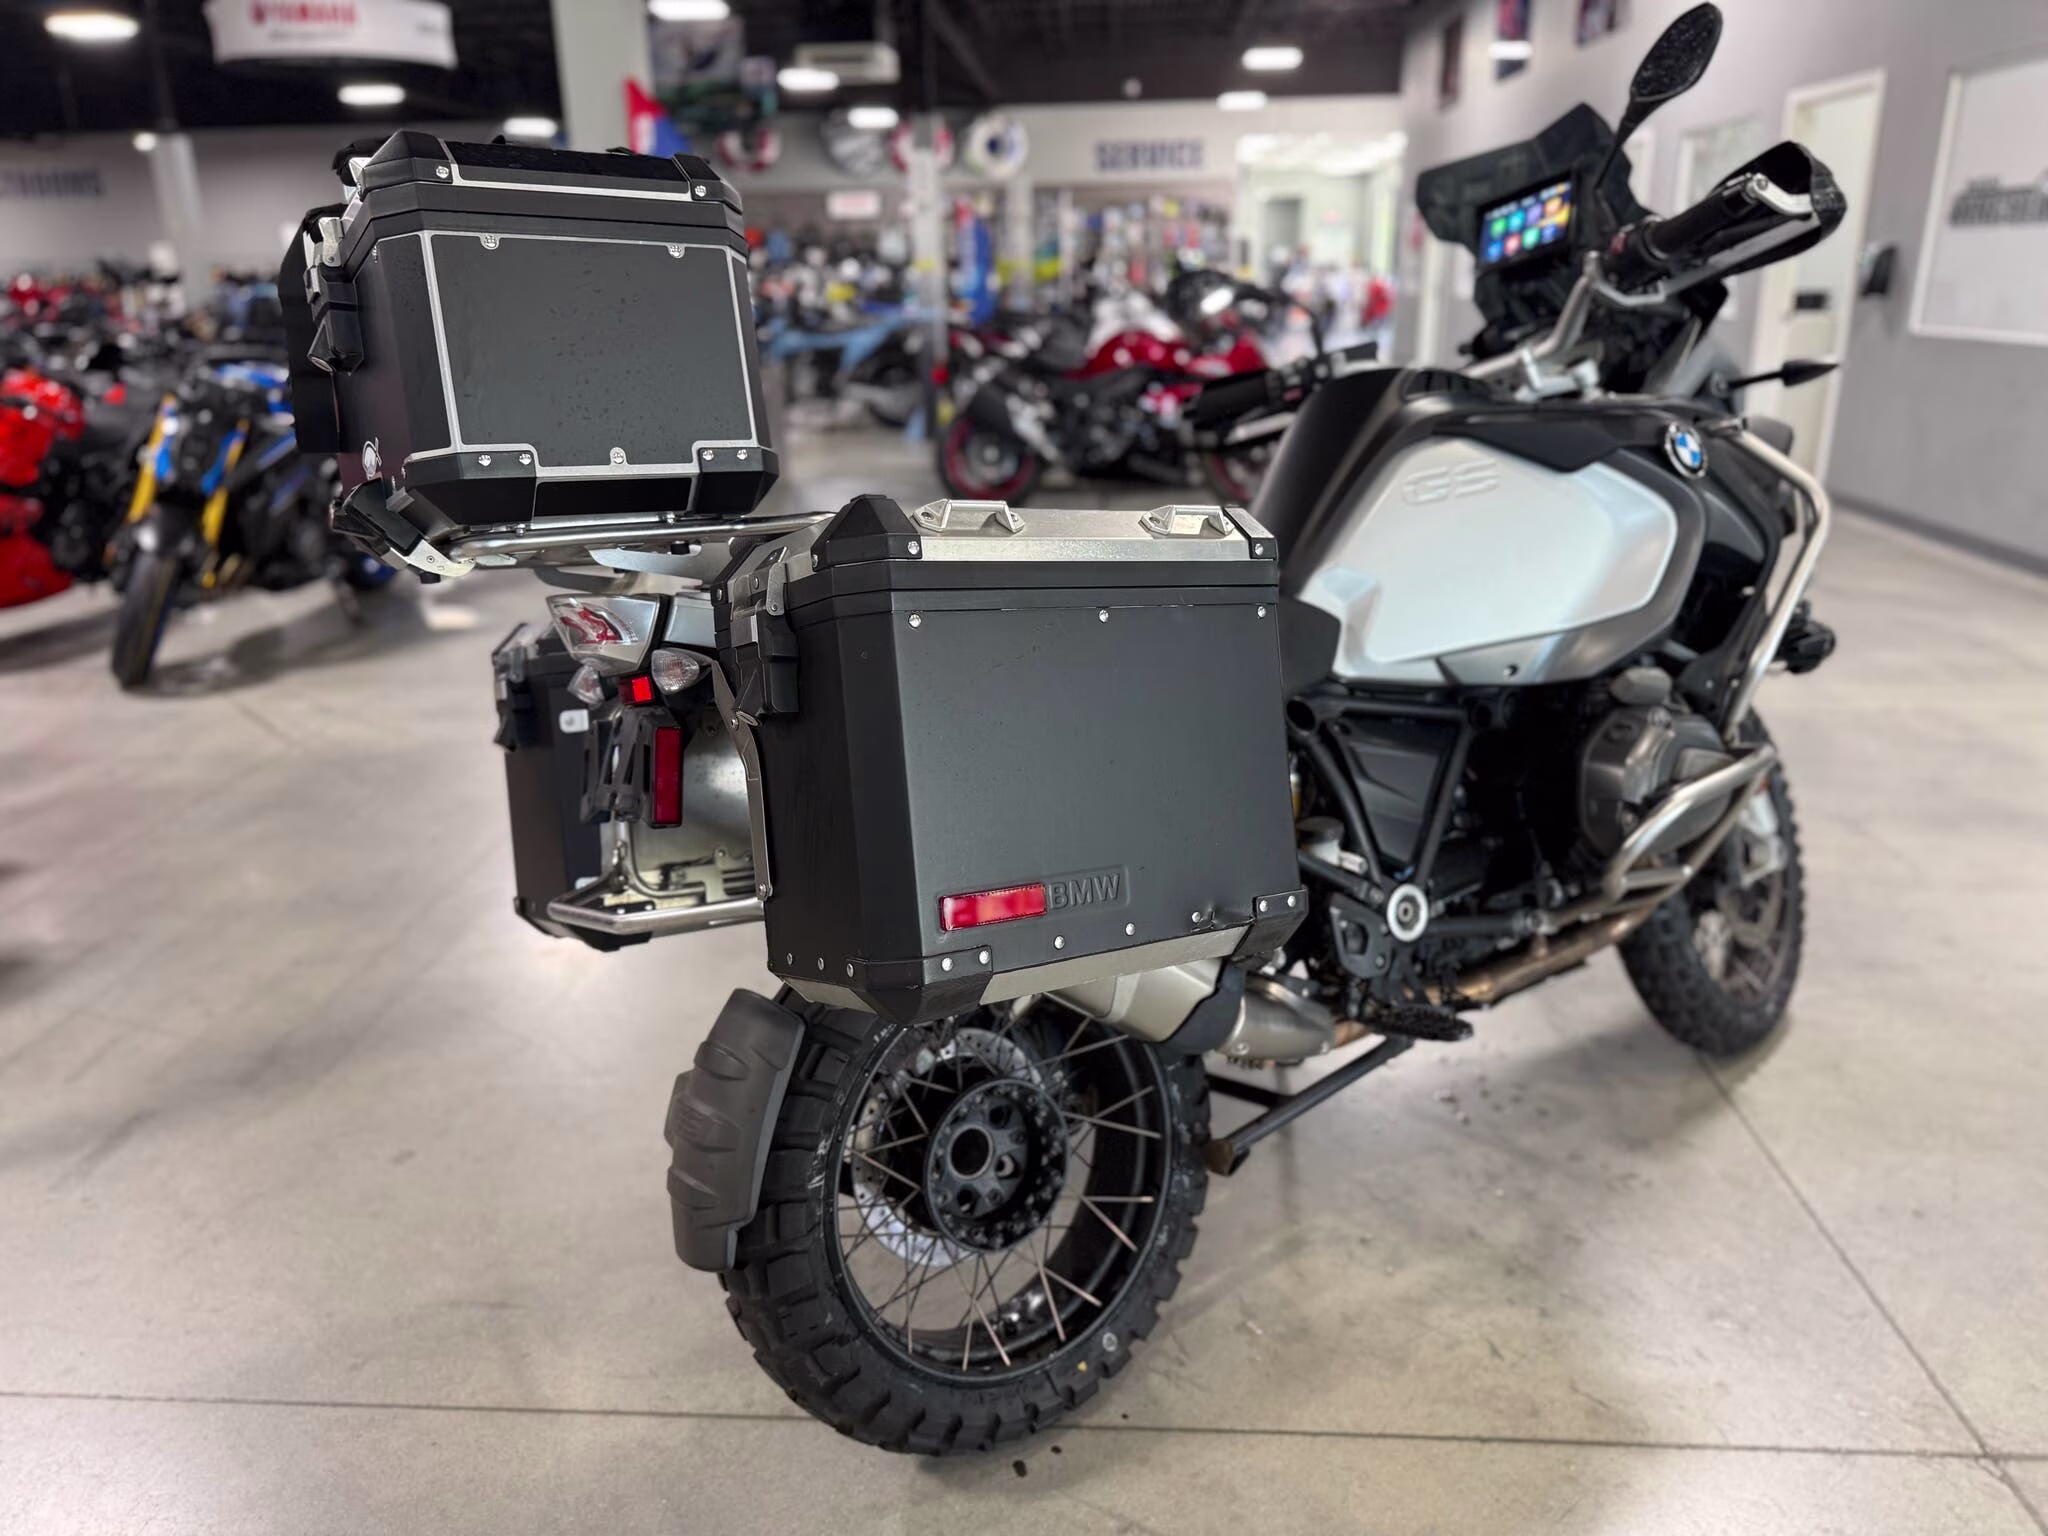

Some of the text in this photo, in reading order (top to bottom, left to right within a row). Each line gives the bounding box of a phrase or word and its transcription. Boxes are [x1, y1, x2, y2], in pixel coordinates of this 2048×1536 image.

[1096, 141, 1204, 170] SERVICE
[1401, 460, 1499, 505] GS
[1049, 873, 1120, 910] BMW
